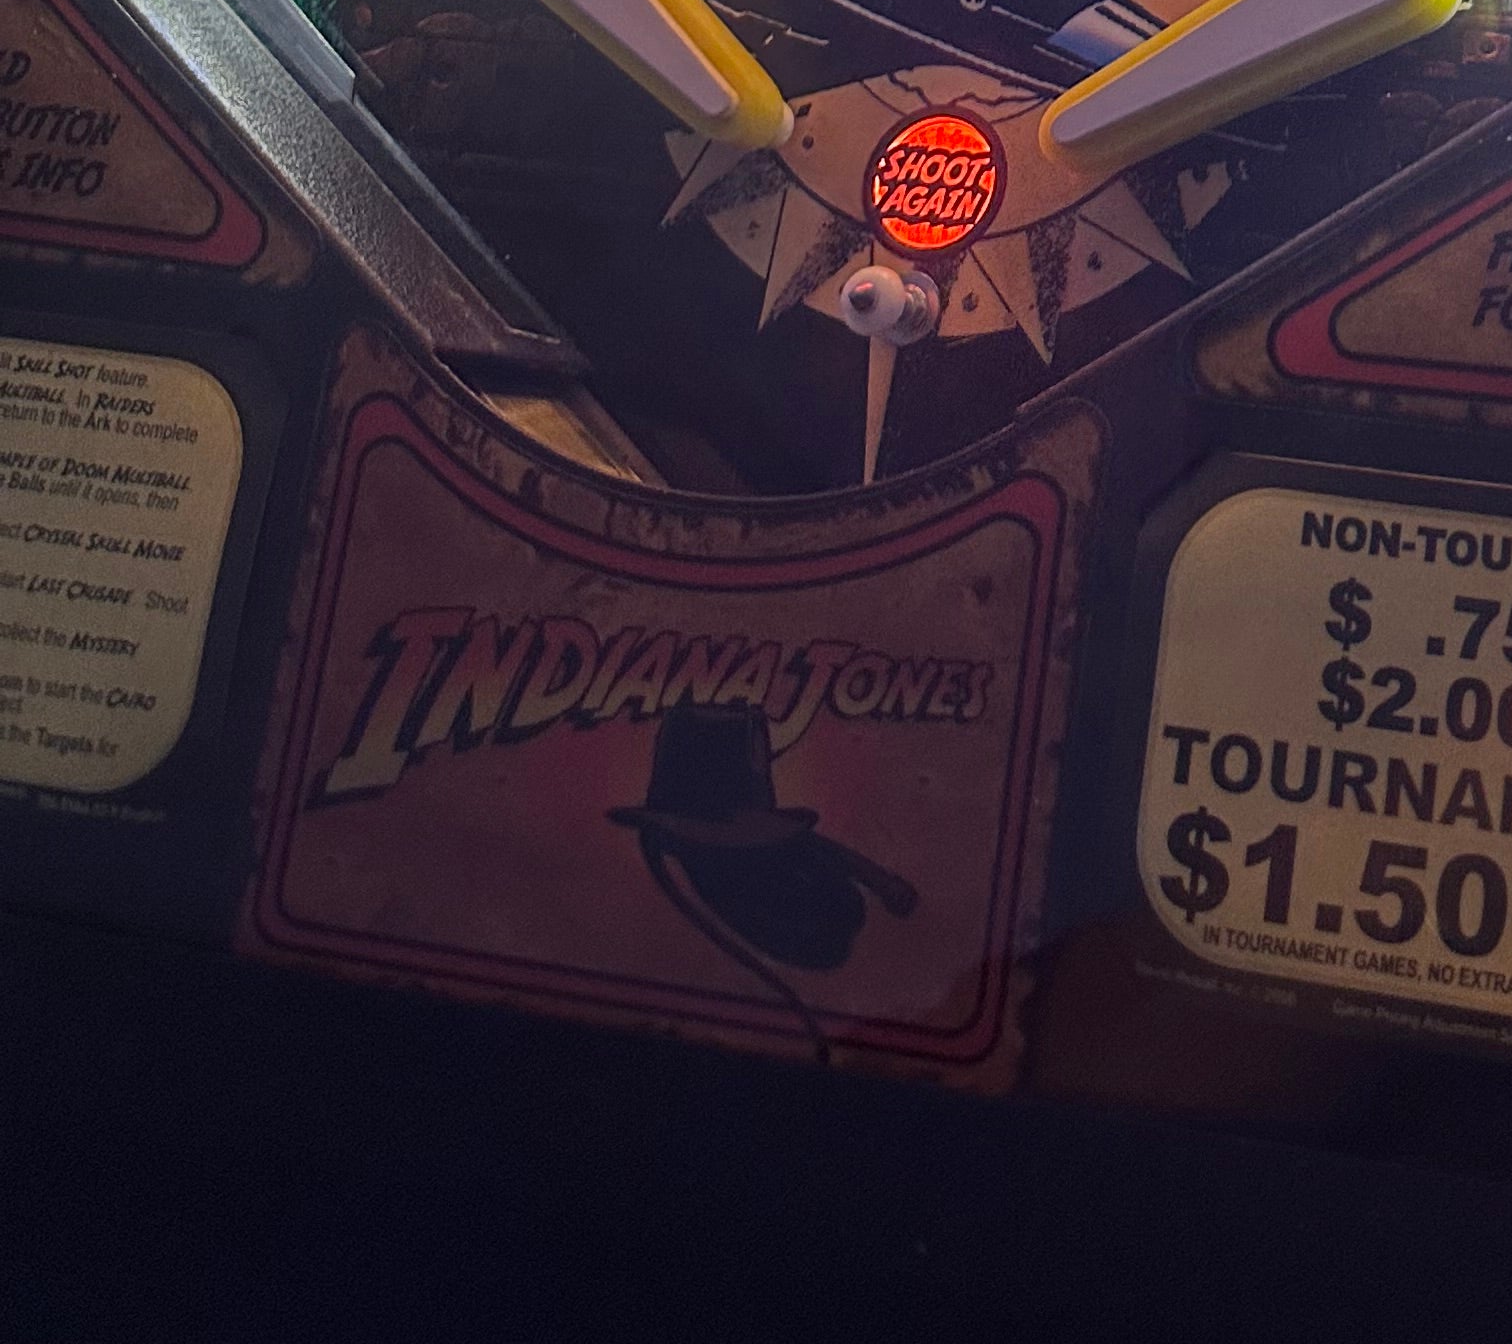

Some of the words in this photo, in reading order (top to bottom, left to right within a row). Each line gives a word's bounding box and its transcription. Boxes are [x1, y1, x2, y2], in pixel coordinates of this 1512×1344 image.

[12, 151, 107, 197] INFO
[883, 149, 991, 187] SHOOT
[880, 183, 983, 221] AGAIN
[76, 388, 91, 409] In
[94, 392, 156, 416] RAIDERS
[41, 407, 55, 424] to
[59, 409, 82, 429] the
[83, 413, 111, 431] Ark
[116, 417, 129, 434] to
[132, 420, 199, 445] complete
[61, 458, 111, 480] DOOM
[8, 473, 45, 492] Balls
[146, 491, 180, 511] then
[318, 605, 784, 796] INDIANA
[770, 637, 995, 759] JONES
[1203, 924, 1222, 945] IN
[1227, 927, 1348, 965] TOURNAMENT
[1354, 950, 1422, 982] GAMES,
[1427, 962, 1455, 984] NO
